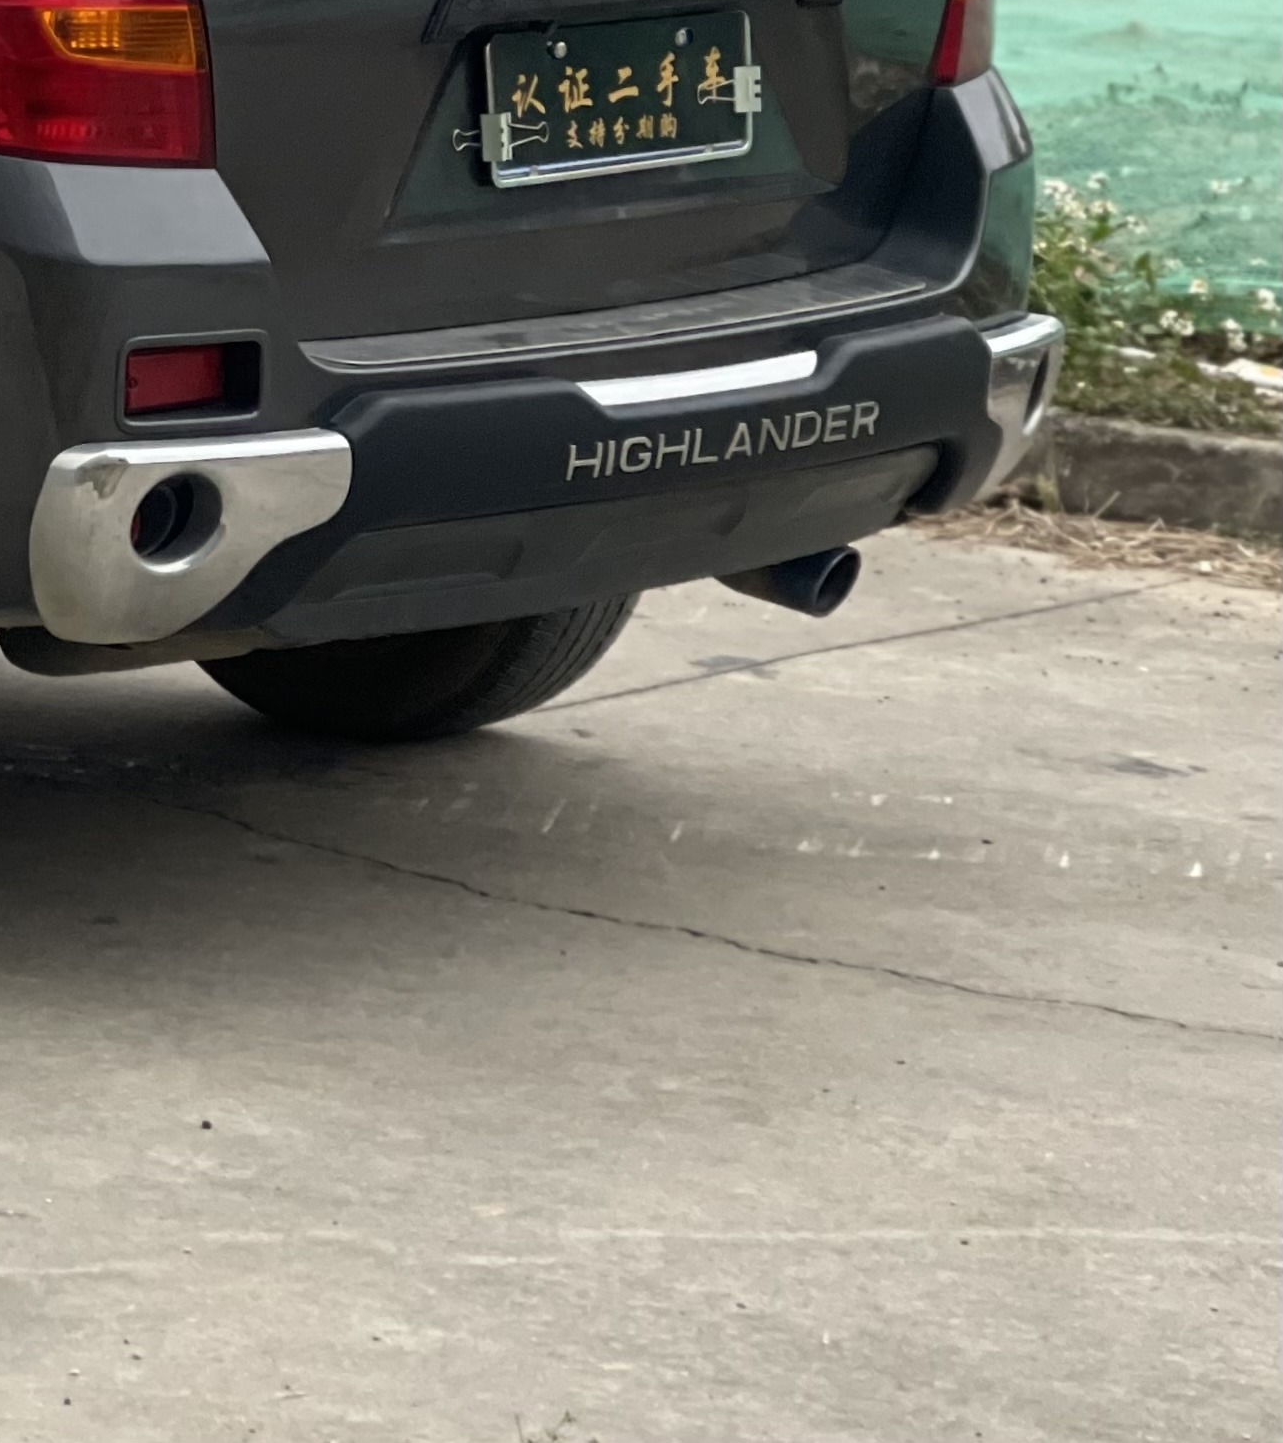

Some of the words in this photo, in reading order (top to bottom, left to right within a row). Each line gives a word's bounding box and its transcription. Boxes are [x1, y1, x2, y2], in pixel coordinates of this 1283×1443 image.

[511, 45, 727, 118] 认证二手车
[565, 112, 678, 150] 支持分期购
[564, 400, 882, 482] HIGHLANDER
